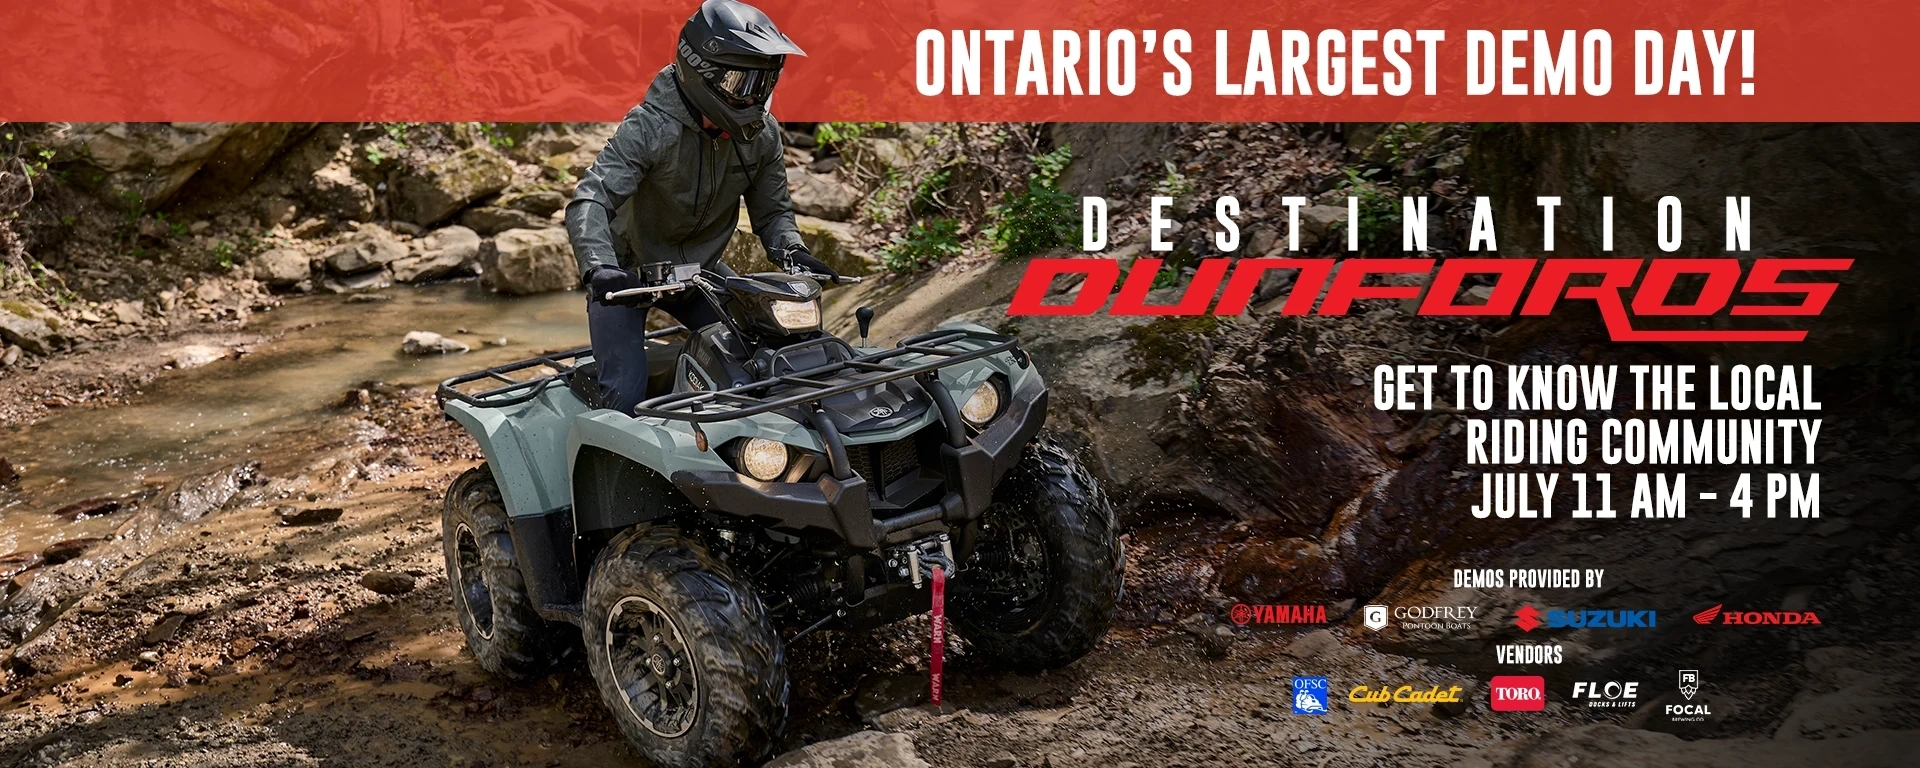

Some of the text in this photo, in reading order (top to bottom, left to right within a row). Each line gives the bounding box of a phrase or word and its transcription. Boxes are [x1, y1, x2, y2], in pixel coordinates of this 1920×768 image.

[678, 38, 719, 79] 100%
[933, 614, 943, 644] WARN
[931, 673, 940, 701] WARN
